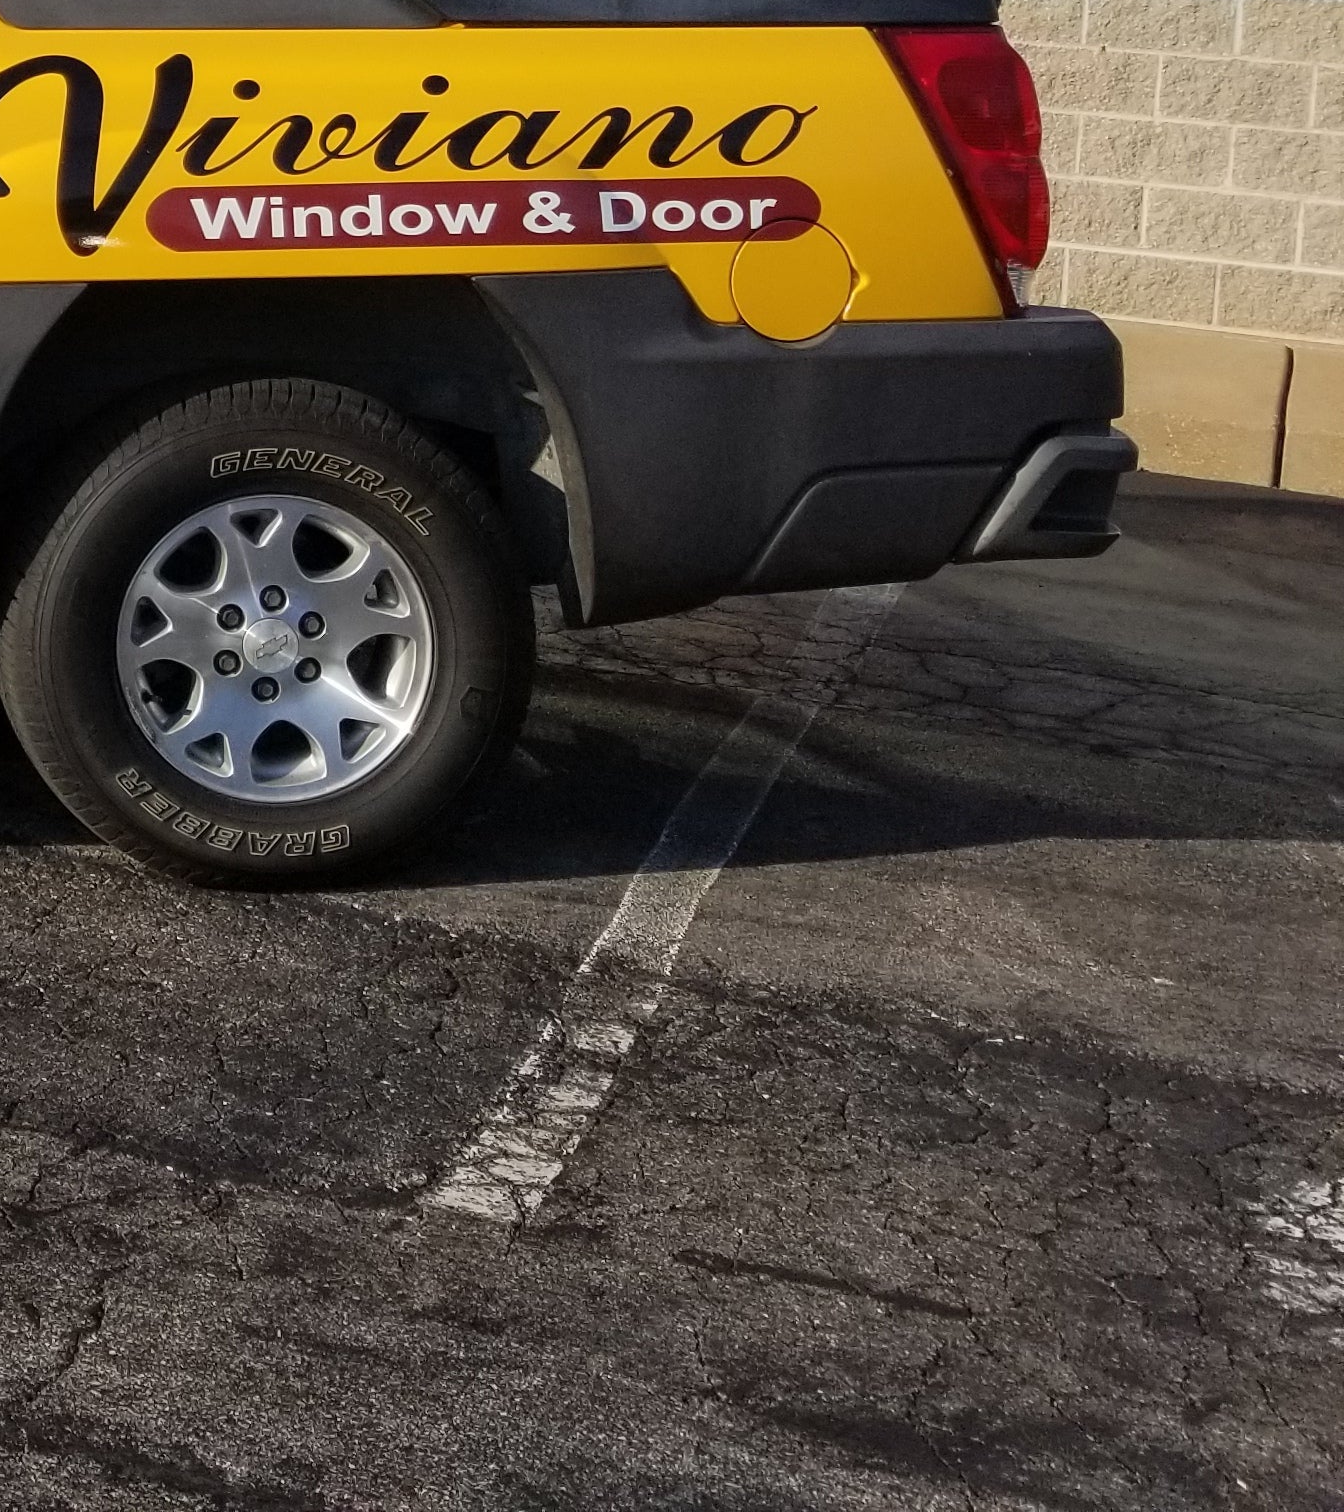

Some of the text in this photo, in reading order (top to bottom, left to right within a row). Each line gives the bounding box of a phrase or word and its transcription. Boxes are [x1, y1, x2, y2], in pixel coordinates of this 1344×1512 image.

[190, 188, 778, 241] Window & Door
[209, 446, 435, 537] GENERAL
[115, 766, 351, 857] GRABBER
